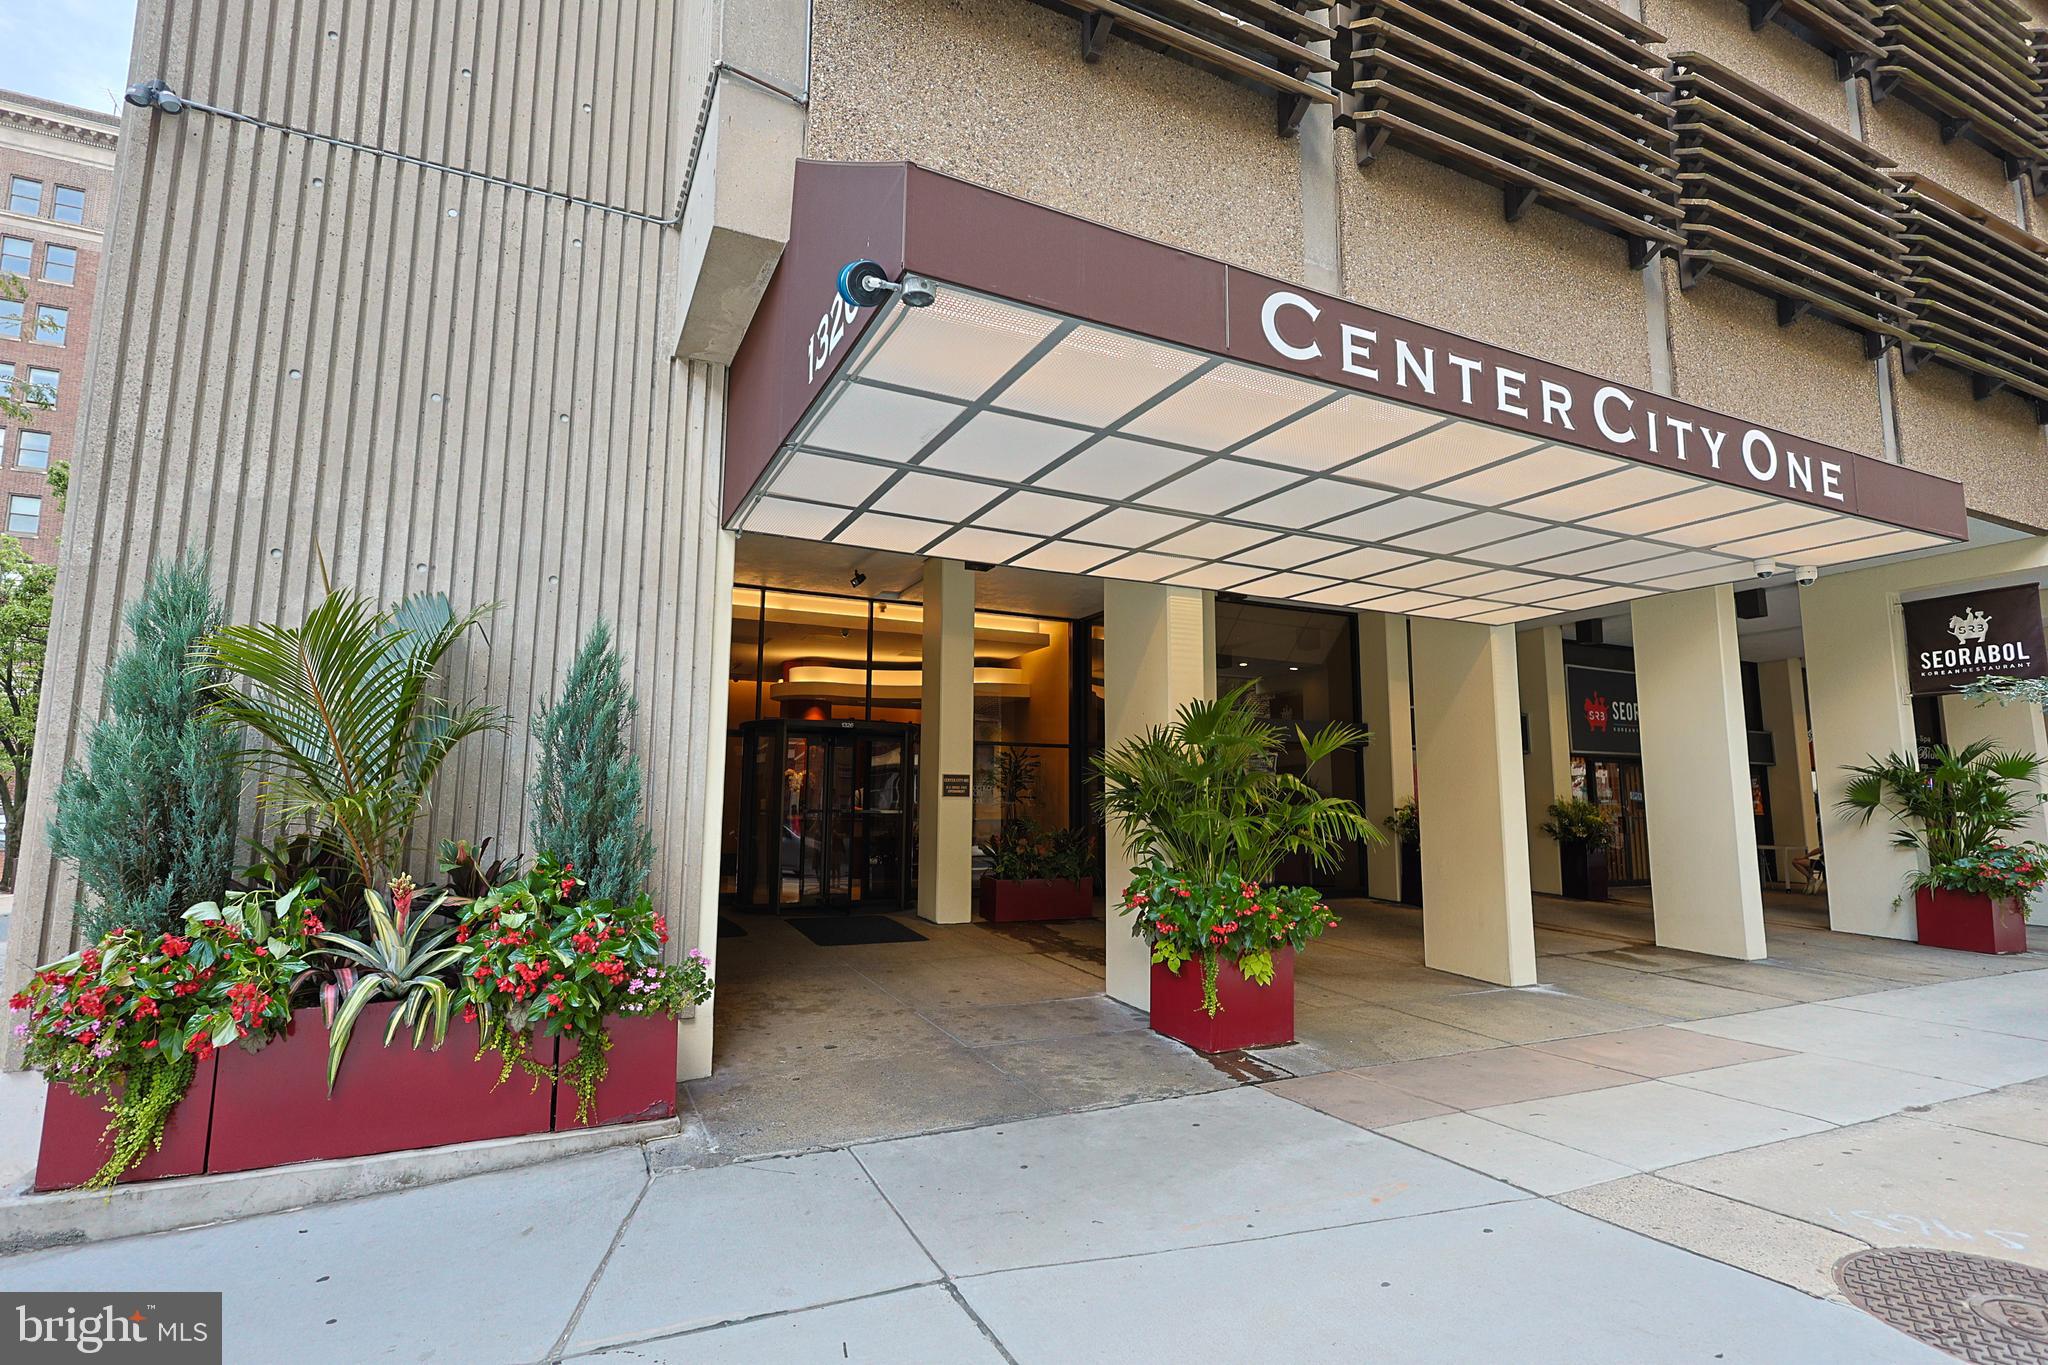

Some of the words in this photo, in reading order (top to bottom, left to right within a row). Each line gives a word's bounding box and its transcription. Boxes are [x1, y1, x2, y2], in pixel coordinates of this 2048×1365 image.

[1261, 291, 1576, 431] CENTER
[1593, 386, 1727, 469] CITY
[1741, 429, 1845, 502] ONE
[1958, 623, 1985, 635] SRB
[1920, 641, 2031, 670] SEORABOL
